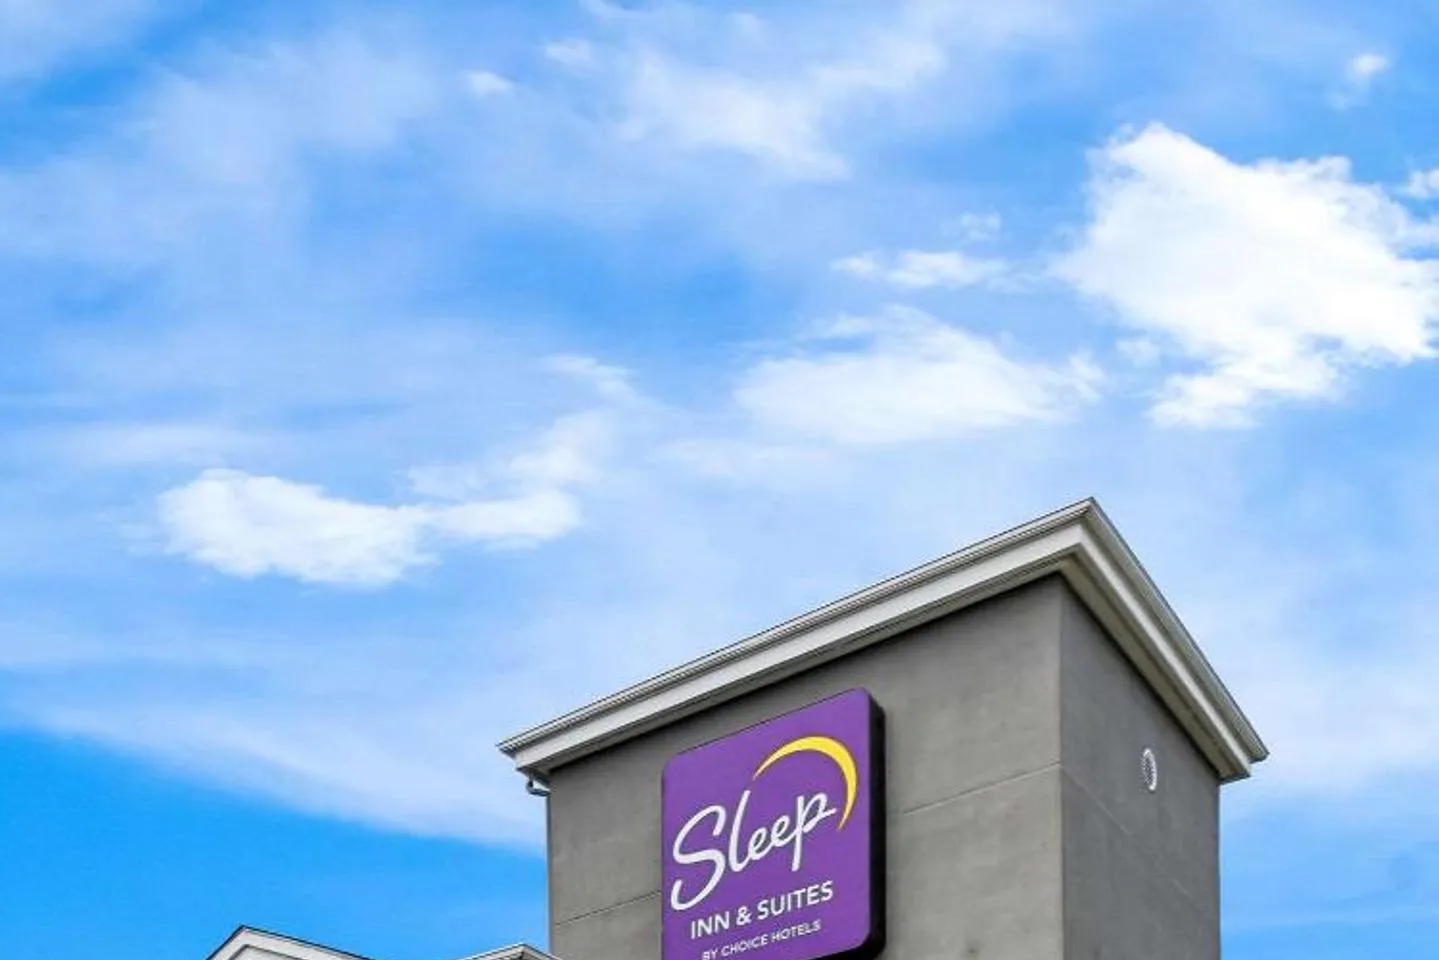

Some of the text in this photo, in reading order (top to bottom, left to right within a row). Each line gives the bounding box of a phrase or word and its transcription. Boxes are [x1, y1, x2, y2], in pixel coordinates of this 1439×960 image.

[670, 790, 837, 910] Sleep
[691, 881, 834, 939] INN & SUITES
[721, 934, 769, 957] CHOICE
[771, 919, 822, 943] HOTELS
